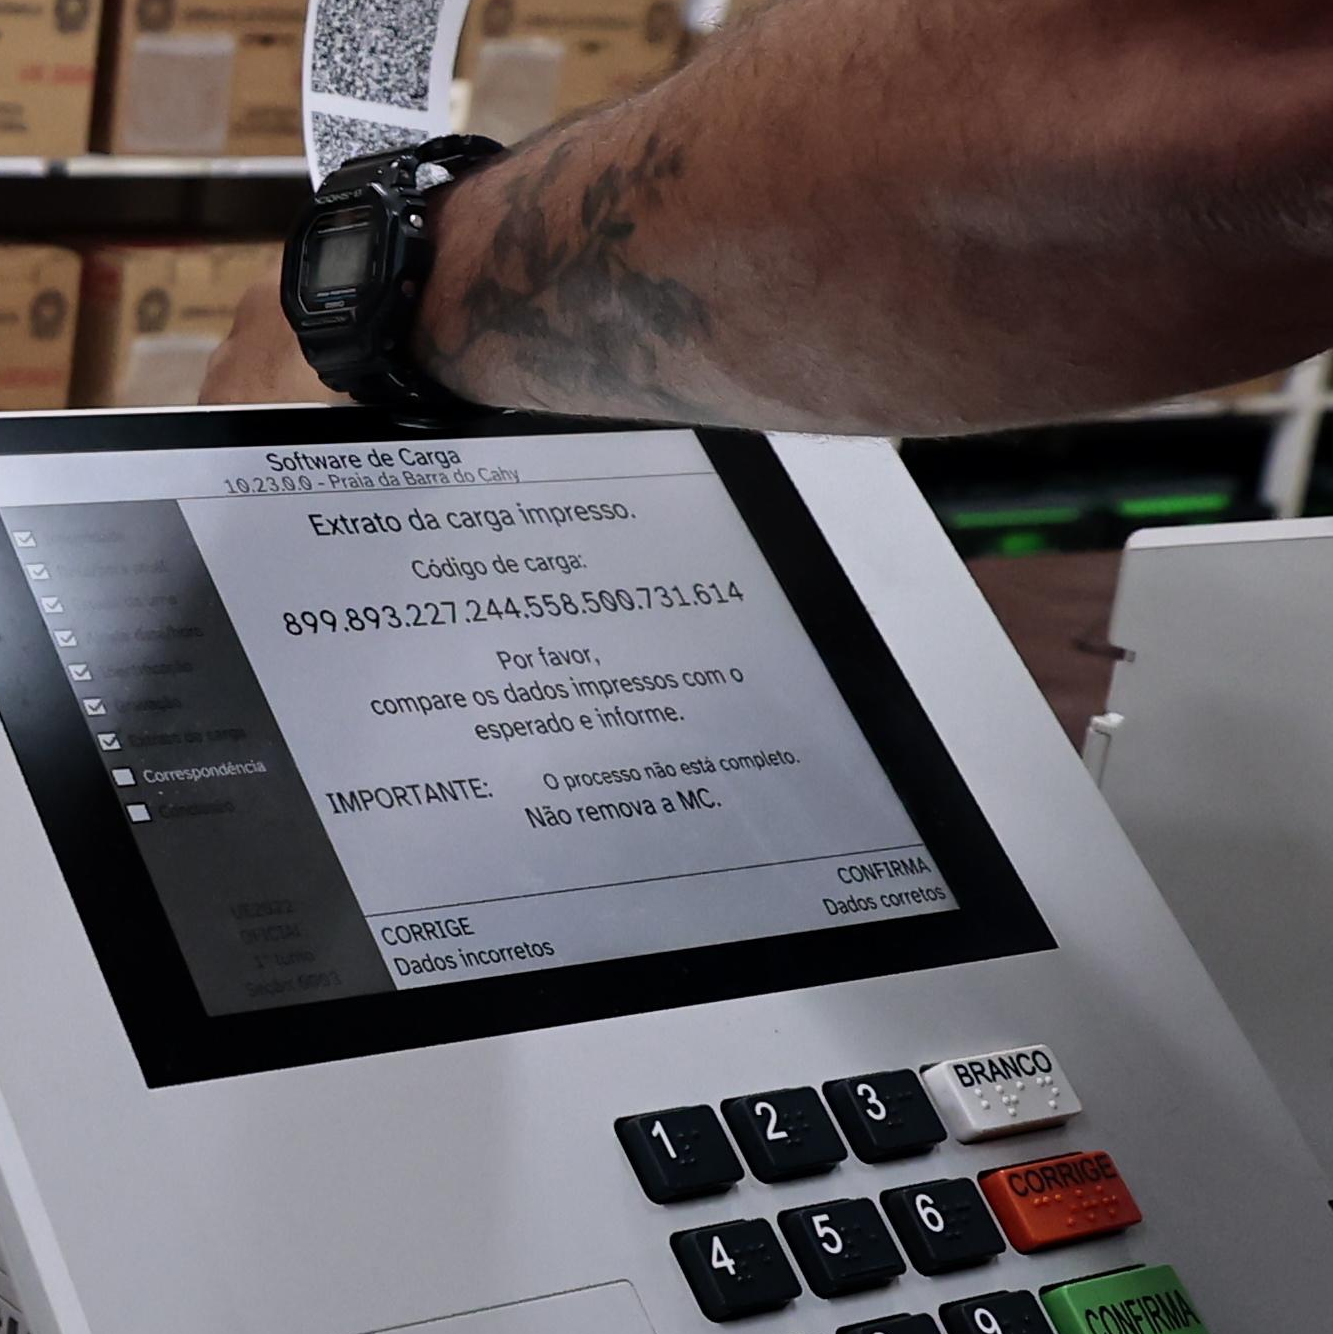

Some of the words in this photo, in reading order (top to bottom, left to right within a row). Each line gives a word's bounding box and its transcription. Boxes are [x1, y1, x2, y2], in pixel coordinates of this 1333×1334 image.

[266, 450, 362, 472] Software
[367, 448, 393, 467] de
[399, 446, 461, 470] Carga
[225, 474, 312, 495] 10.23.0.0
[328, 472, 373, 490] Praia
[378, 470, 400, 488] da
[403, 469, 450, 486] Barra
[454, 467, 475, 484] do
[478, 465, 520, 485] Cahy
[308, 512, 402, 537] Extrato
[409, 511, 440, 532] da
[447, 508, 515, 532] carga
[519, 500, 637, 528] impresso.
[411, 556, 488, 580] Código
[492, 554, 519, 574] de
[524, 551, 587, 575] carga:
[282, 580, 744, 637] 899.893.227.244.558.500.731.614
[497, 648, 534, 671] Por
[538, 644, 600, 667] favor,
[370, 688, 468, 718] compare
[473, 687, 499, 708] os
[504, 677, 569, 703] dados
[572, 670, 679, 701] impressos
[684, 669, 725, 690] com
[730, 667, 745, 684] o
[474, 714, 575, 743] esperado
[580, 713, 594, 730] e
[596, 701, 685, 728] informe.
[143, 758, 268, 784] Correspondência
[543, 772, 559, 792] O
[564, 764, 642, 793] processo
[644, 760, 677, 782] não
[680, 753, 716, 777] está
[719, 747, 800, 774] completo.
[325, 776, 495, 815] IMPORTANTE:
[525, 803, 572, 829] Não
[577, 797, 658, 823] remova
[661, 794, 676, 812] a
[679, 786, 722, 812] MC.
[837, 856, 933, 887] CONFIRMA
[822, 893, 877, 918] Dados
[880, 884, 947, 911] corretos
[380, 915, 475, 947] CORRIGE
[394, 951, 457, 977] Dados
[459, 938, 556, 970] incorretos
[953, 1049, 1053, 1088] BRANCO
[755, 1102, 789, 1140] 2
[857, 1084, 887, 1121] 3
[651, 1120, 679, 1159] 1
[1008, 1155, 1116, 1197] CORRIGE
[915, 1194, 944, 1233] 6
[815, 1215, 844, 1254] 5
[710, 1236, 737, 1275] 4
